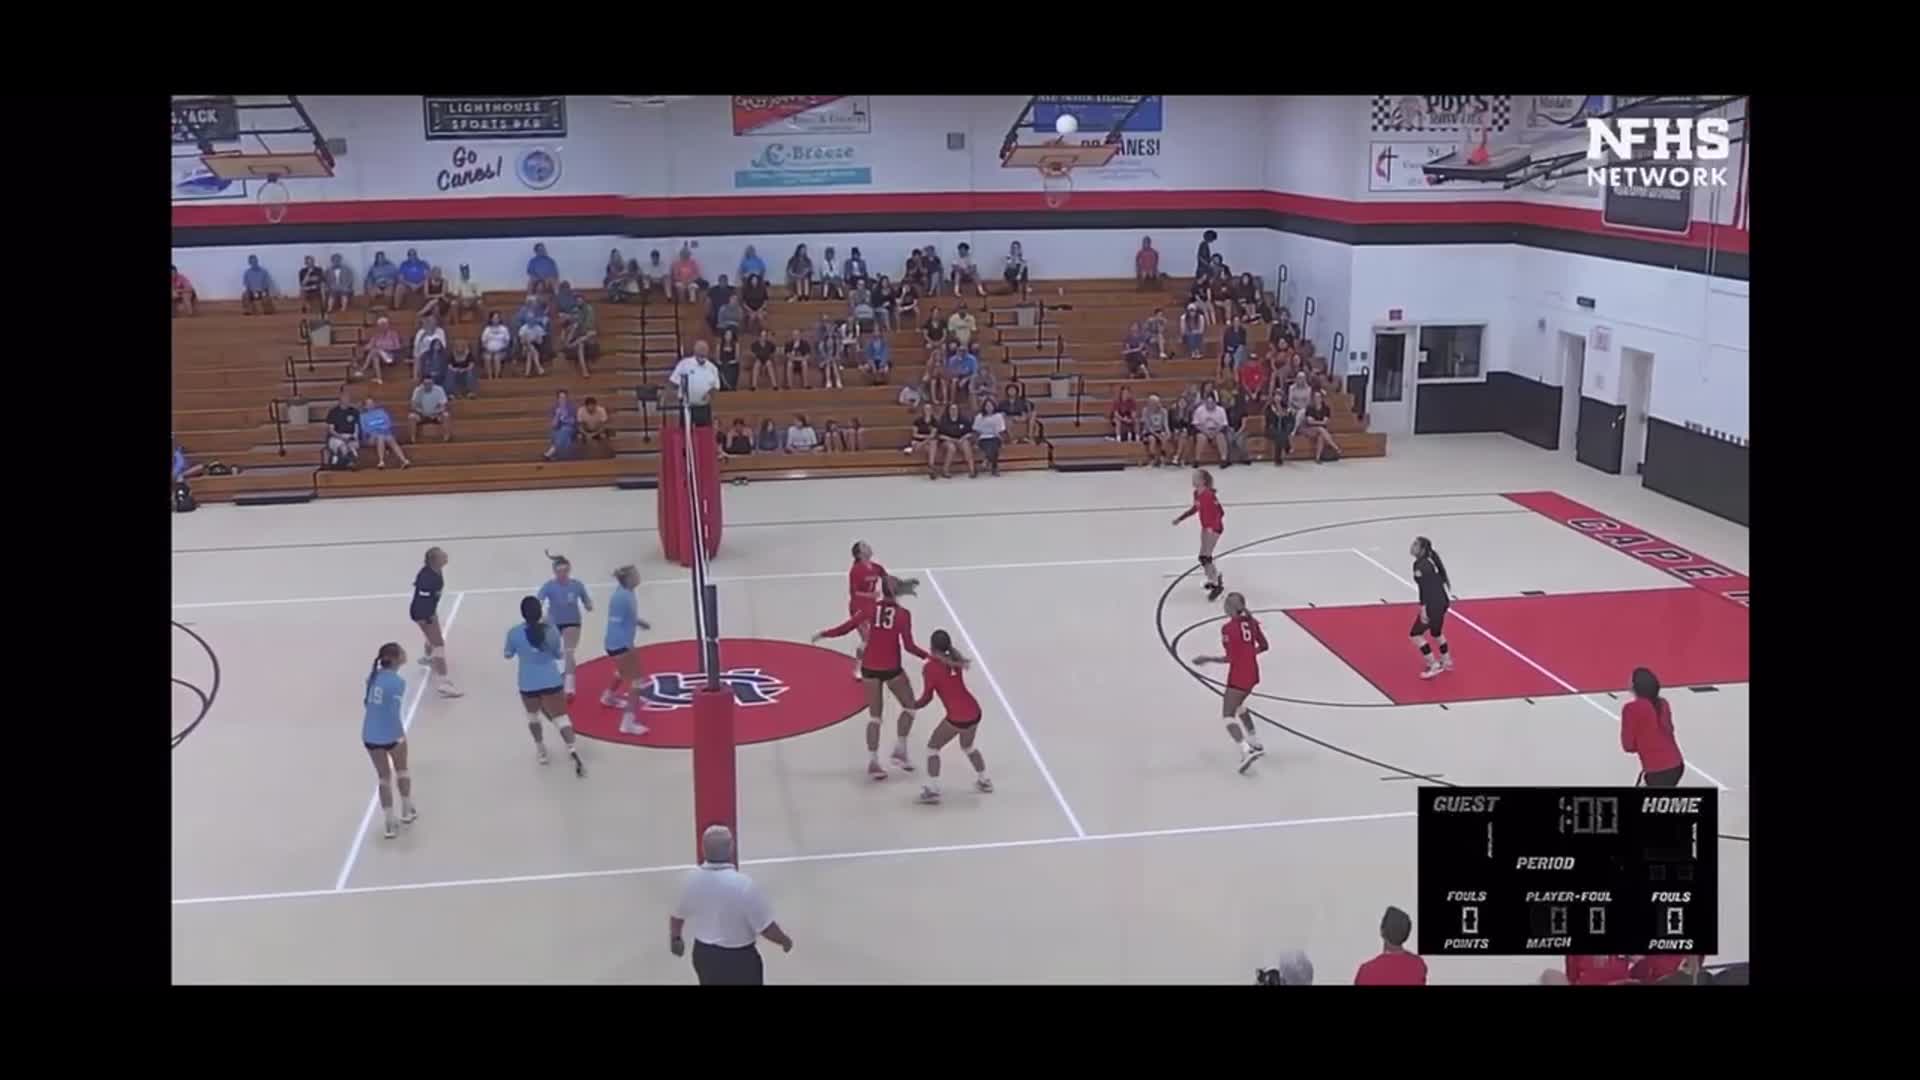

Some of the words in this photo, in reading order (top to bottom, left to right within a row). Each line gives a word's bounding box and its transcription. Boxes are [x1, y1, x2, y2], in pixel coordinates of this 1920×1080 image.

[448, 101, 541, 114] LIGHTHOUSE
[451, 118, 507, 130] SPORTS
[513, 118, 541, 129] BAR
[452, 145, 478, 169] Go
[436, 155, 503, 192] Canes!
[874, 605, 896, 630] 13
[1241, 621, 1252, 642] 6
